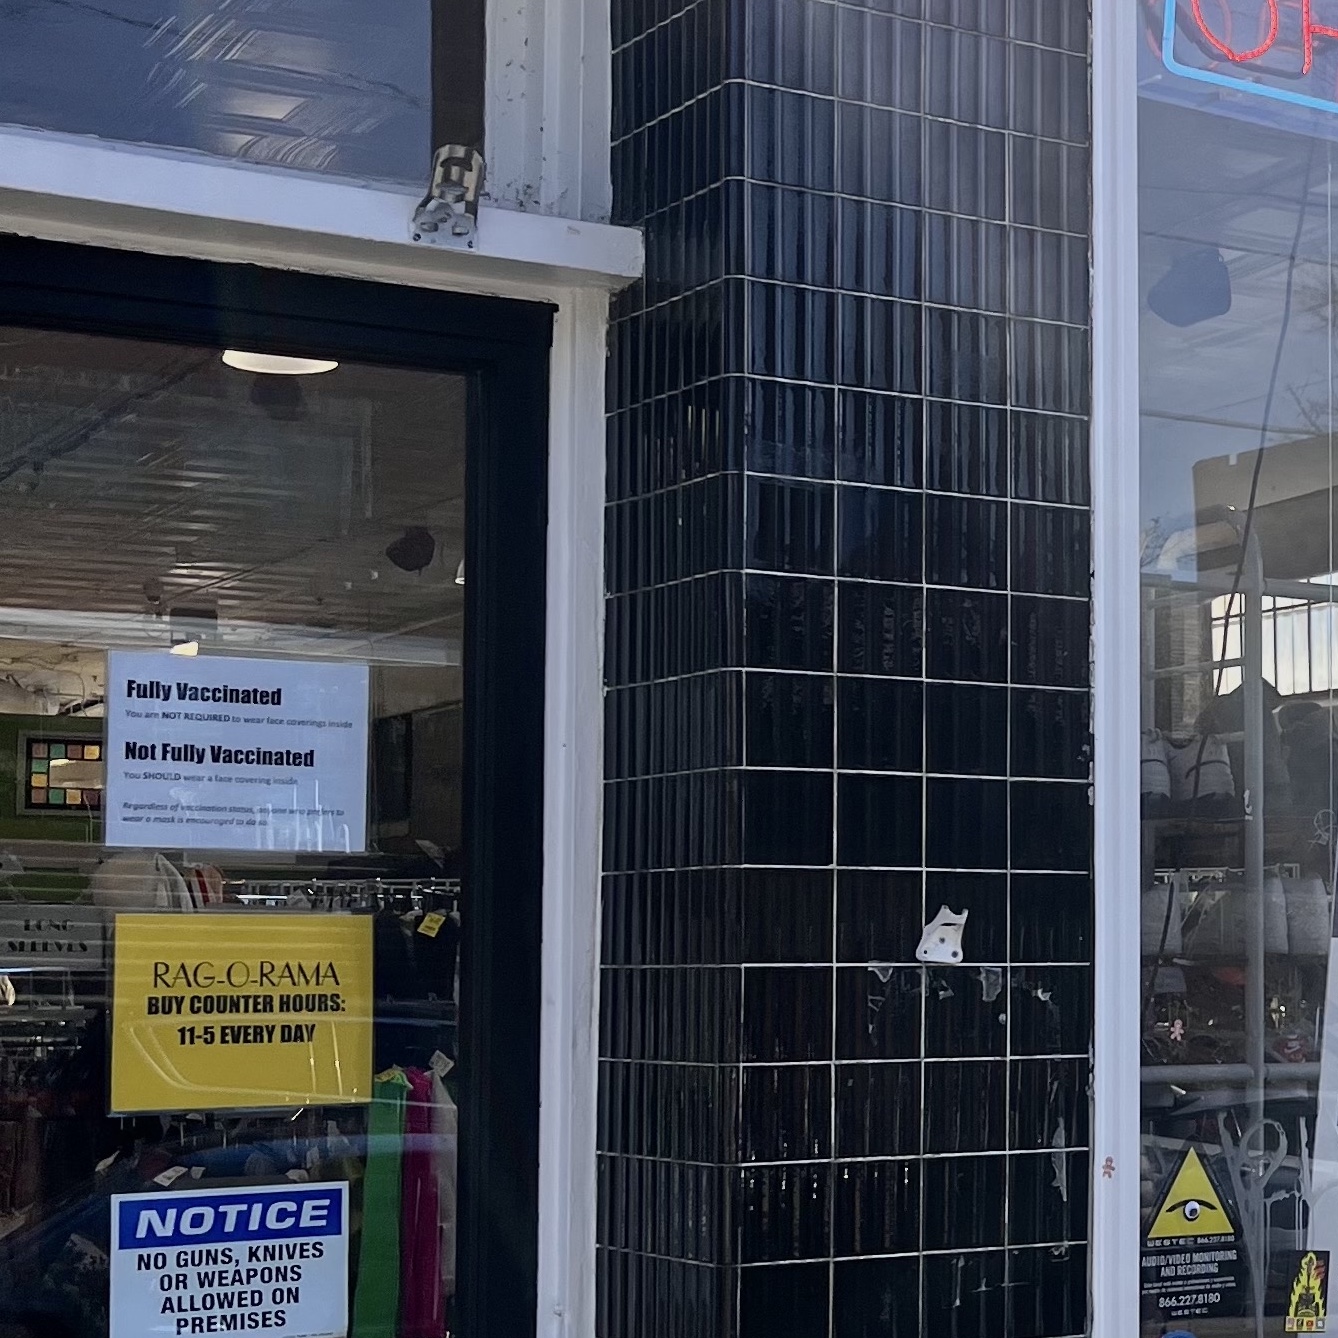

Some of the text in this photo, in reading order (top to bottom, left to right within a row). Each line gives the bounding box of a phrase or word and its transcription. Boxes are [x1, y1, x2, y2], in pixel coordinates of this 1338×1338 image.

[126, 679, 282, 705] Fully Vaccinated
[125, 709, 142, 718] You
[161, 711, 181, 720] NOT
[183, 711, 231, 723] REQUIRED
[231, 715, 241, 723] to
[266, 716, 285, 725] face
[124, 741, 315, 768] Not Fully Vaccinated
[123, 771, 141, 781] You
[142, 771, 182, 782] SHOULD
[153, 960, 341, 989] RAG-O-RAMA
[147, 993, 346, 1016] BUY COUNTER HOURS:
[177, 1024, 316, 1046] 11-5 EVERY DAY
[135, 1199, 331, 1239] NOTICE
[137, 1241, 324, 1271] NO GUNS, KNIVES
[1141, 1249, 1238, 1268] AUDIO/VIDEO MONITORING
[159, 1264, 303, 1292] OR WEAPONS
[1160, 1262, 1219, 1278] AND RECORDING
[160, 1286, 300, 1314] ALLOWED ON
[1158, 1292, 1221, 1308] 866.227.8180
[176, 1309, 287, 1336] PREMISES
